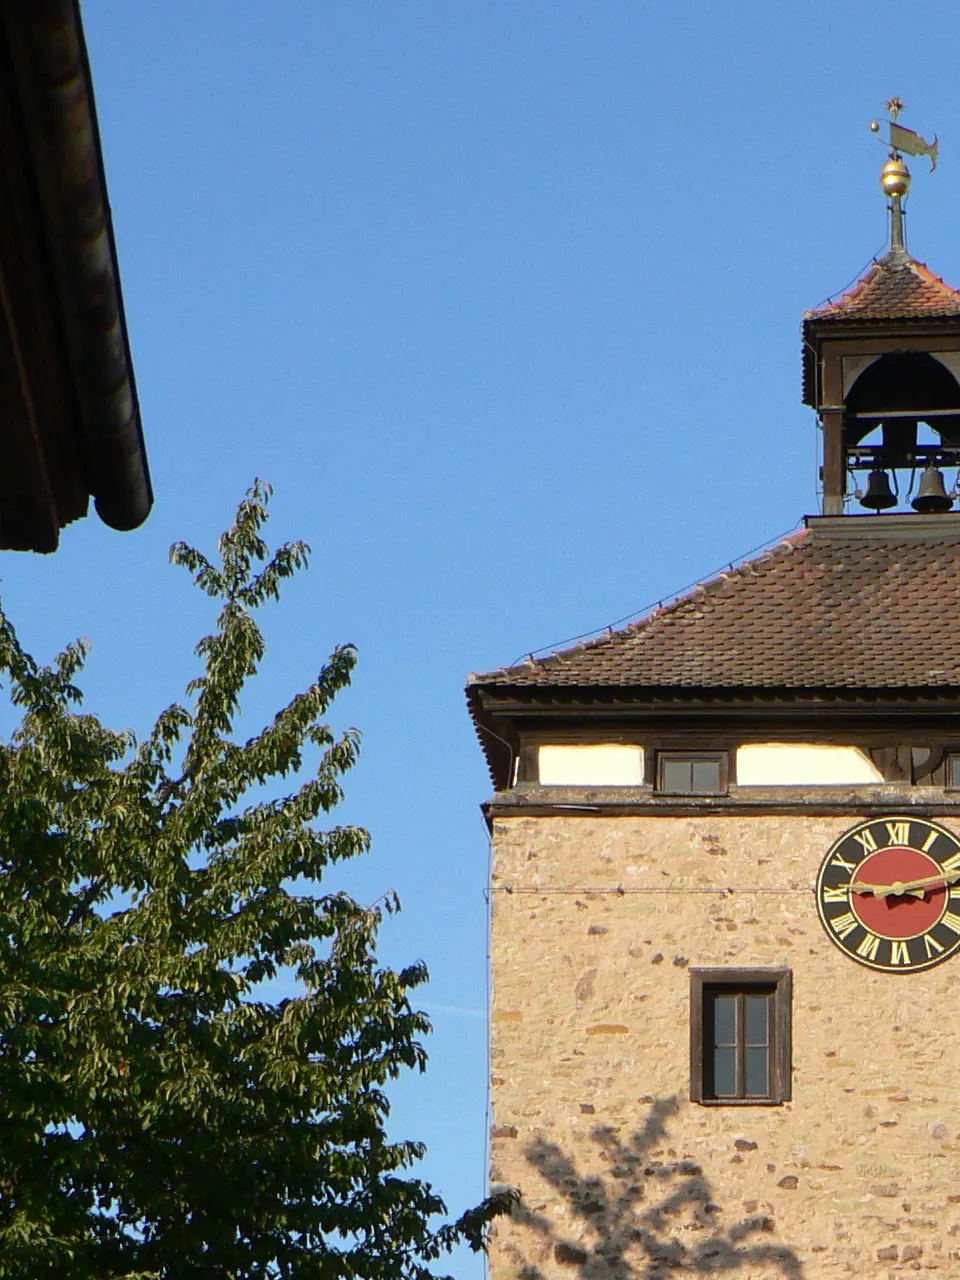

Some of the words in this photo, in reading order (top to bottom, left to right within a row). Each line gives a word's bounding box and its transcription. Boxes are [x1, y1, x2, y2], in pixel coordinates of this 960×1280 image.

[853, 829, 878, 856] XI
[886, 823, 910, 846] XII
[921, 830, 939, 852] I
[831, 853, 856, 874] X
[824, 886, 848, 903] IX
[829, 911, 859, 941] VIII
[856, 933, 880, 961] VII
[890, 942, 911, 965] VI
[923, 934, 945, 959] V
